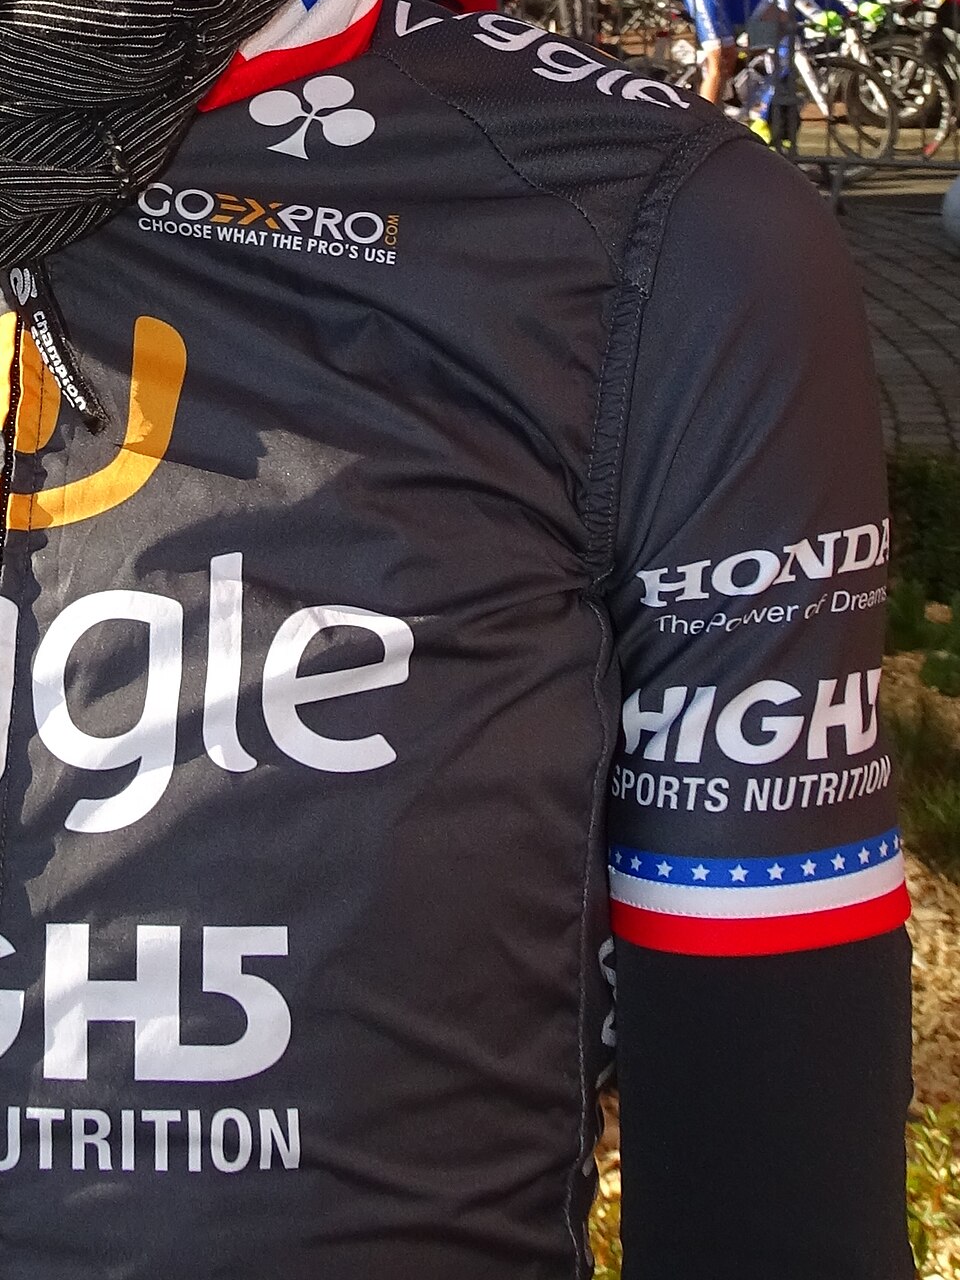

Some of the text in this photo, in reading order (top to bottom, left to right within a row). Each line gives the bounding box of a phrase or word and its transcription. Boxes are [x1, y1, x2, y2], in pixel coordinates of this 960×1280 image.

[138, 216, 397, 265] CHOOSE WHAT THE PRO'S USE
[654, 614, 708, 635] The
[705, 604, 799, 633] Power
[803, 593, 829, 620] of
[611, 754, 892, 813] SPORTS NUTRITION
